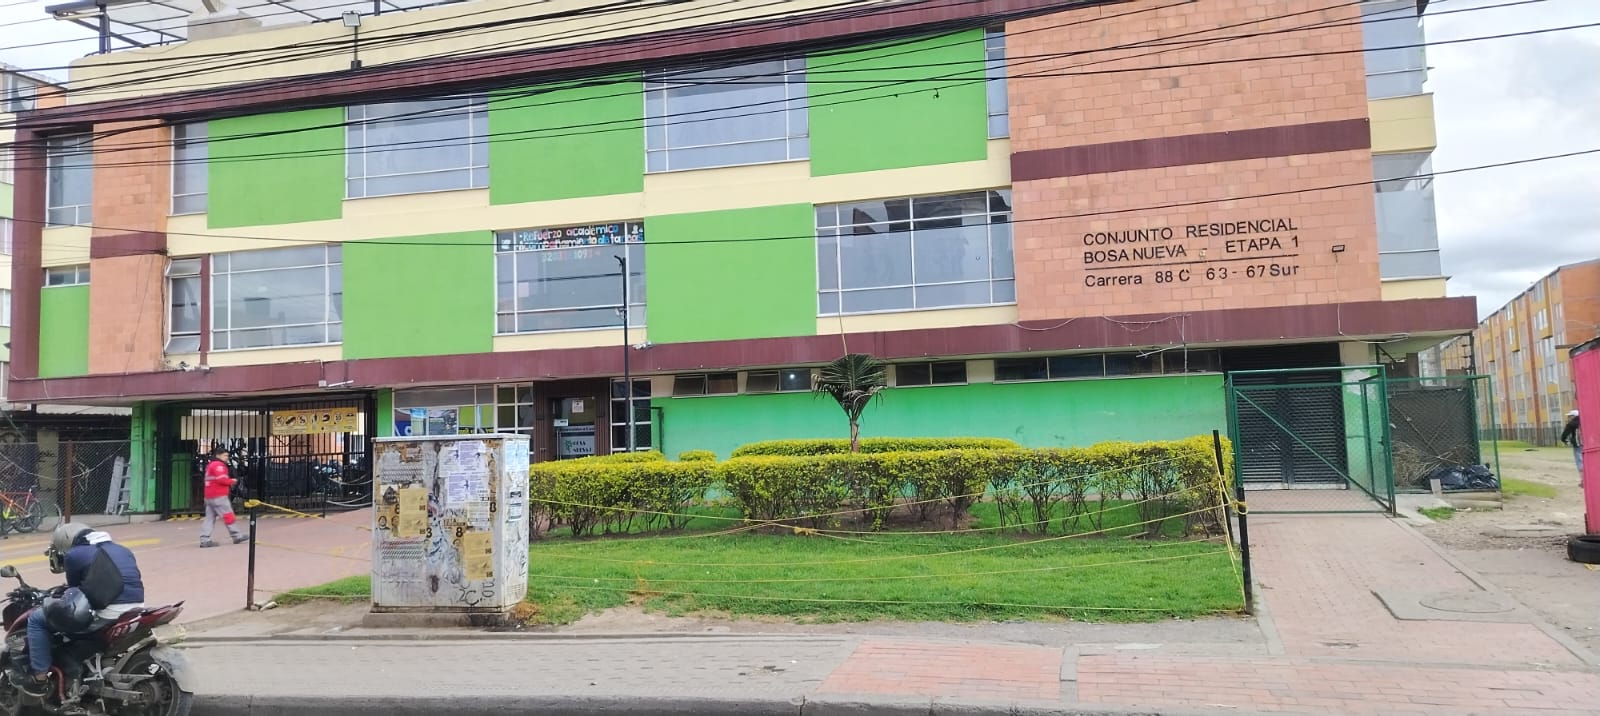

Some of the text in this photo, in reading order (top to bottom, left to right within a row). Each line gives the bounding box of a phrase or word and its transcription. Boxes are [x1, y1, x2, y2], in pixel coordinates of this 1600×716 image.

[1083, 217, 1298, 246] CONJUNTO RESIDENCIAL
[1084, 249, 1130, 264] BOSA
[1133, 244, 1188, 260] NUEVA
[1225, 237, 1282, 254] ETAPA
[1291, 235, 1299, 248] 1
[1085, 274, 1143, 287] Carrera
